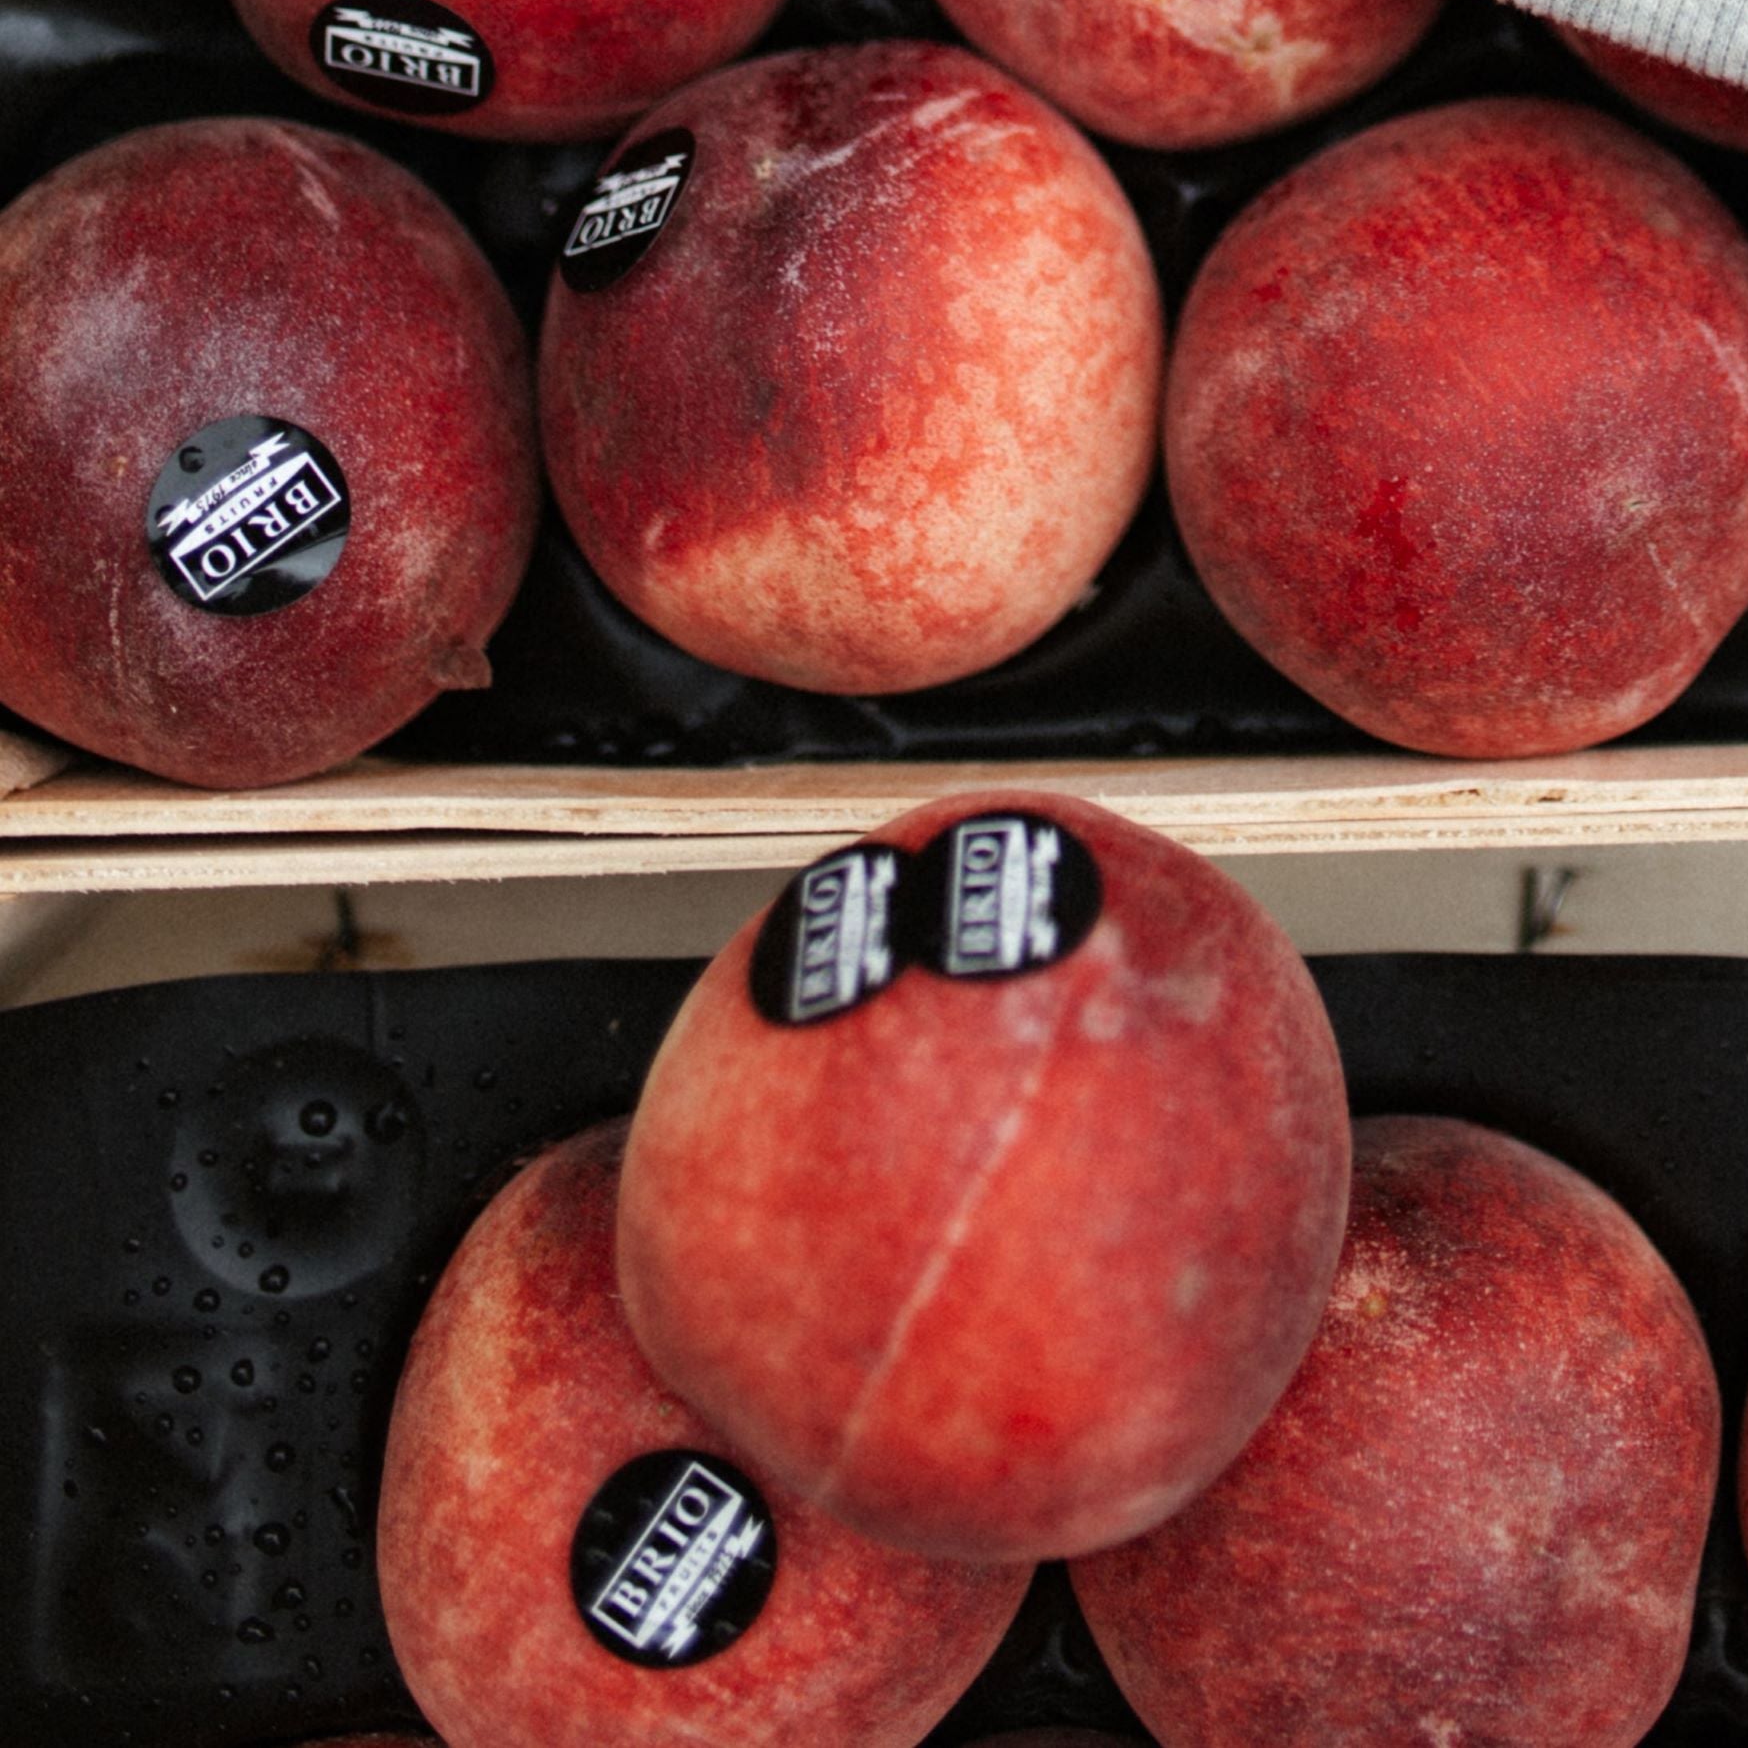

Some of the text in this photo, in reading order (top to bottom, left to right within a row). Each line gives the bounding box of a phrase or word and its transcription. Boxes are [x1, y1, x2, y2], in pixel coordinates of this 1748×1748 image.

[342, 43, 462, 86] BRIO
[579, 196, 660, 245] BRIO
[194, 458, 259, 515] since 1975
[202, 476, 278, 536] FRUITS
[201, 480, 320, 581] BRIO
[610, 1485, 715, 1620] BRIO
[659, 1530, 718, 1610] FRUITS
